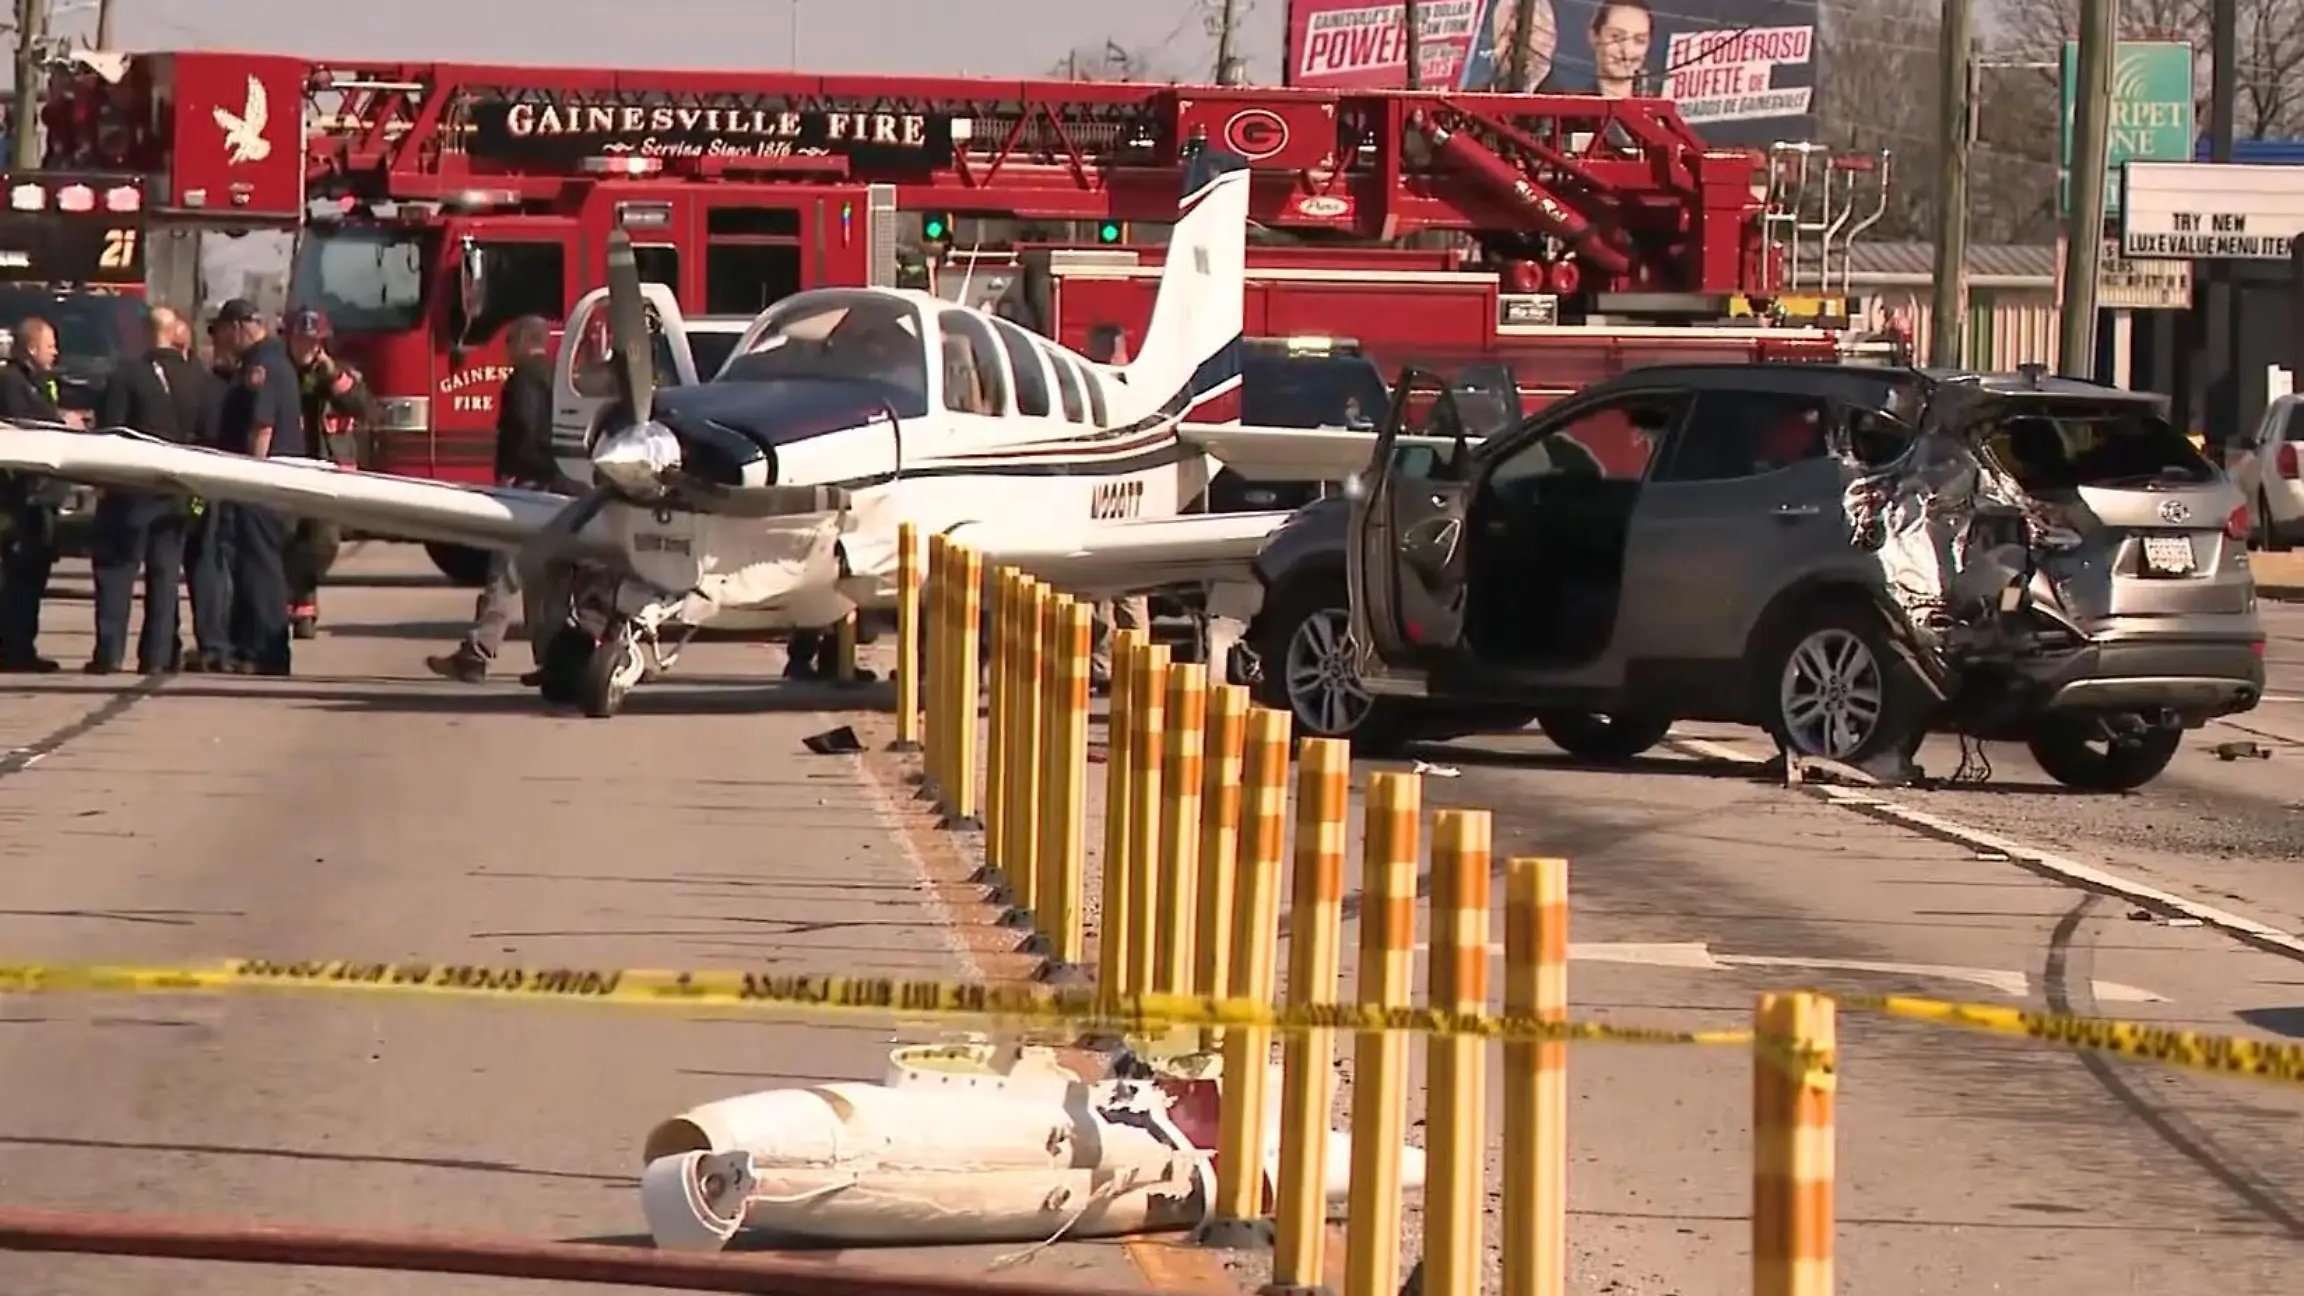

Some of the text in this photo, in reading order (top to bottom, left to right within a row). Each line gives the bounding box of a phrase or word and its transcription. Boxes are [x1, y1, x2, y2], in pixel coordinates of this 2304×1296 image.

[1673, 31, 1808, 67] EL PODEROSO
[1674, 66, 1744, 99] BUFETE
[507, 103, 926, 147] GAINESVILLE FIRE
[640, 136, 703, 157] Serving
[2173, 212, 2246, 233] TRY NEW
[99, 229, 137, 268] 21
[454, 395, 493, 412] FIRE
